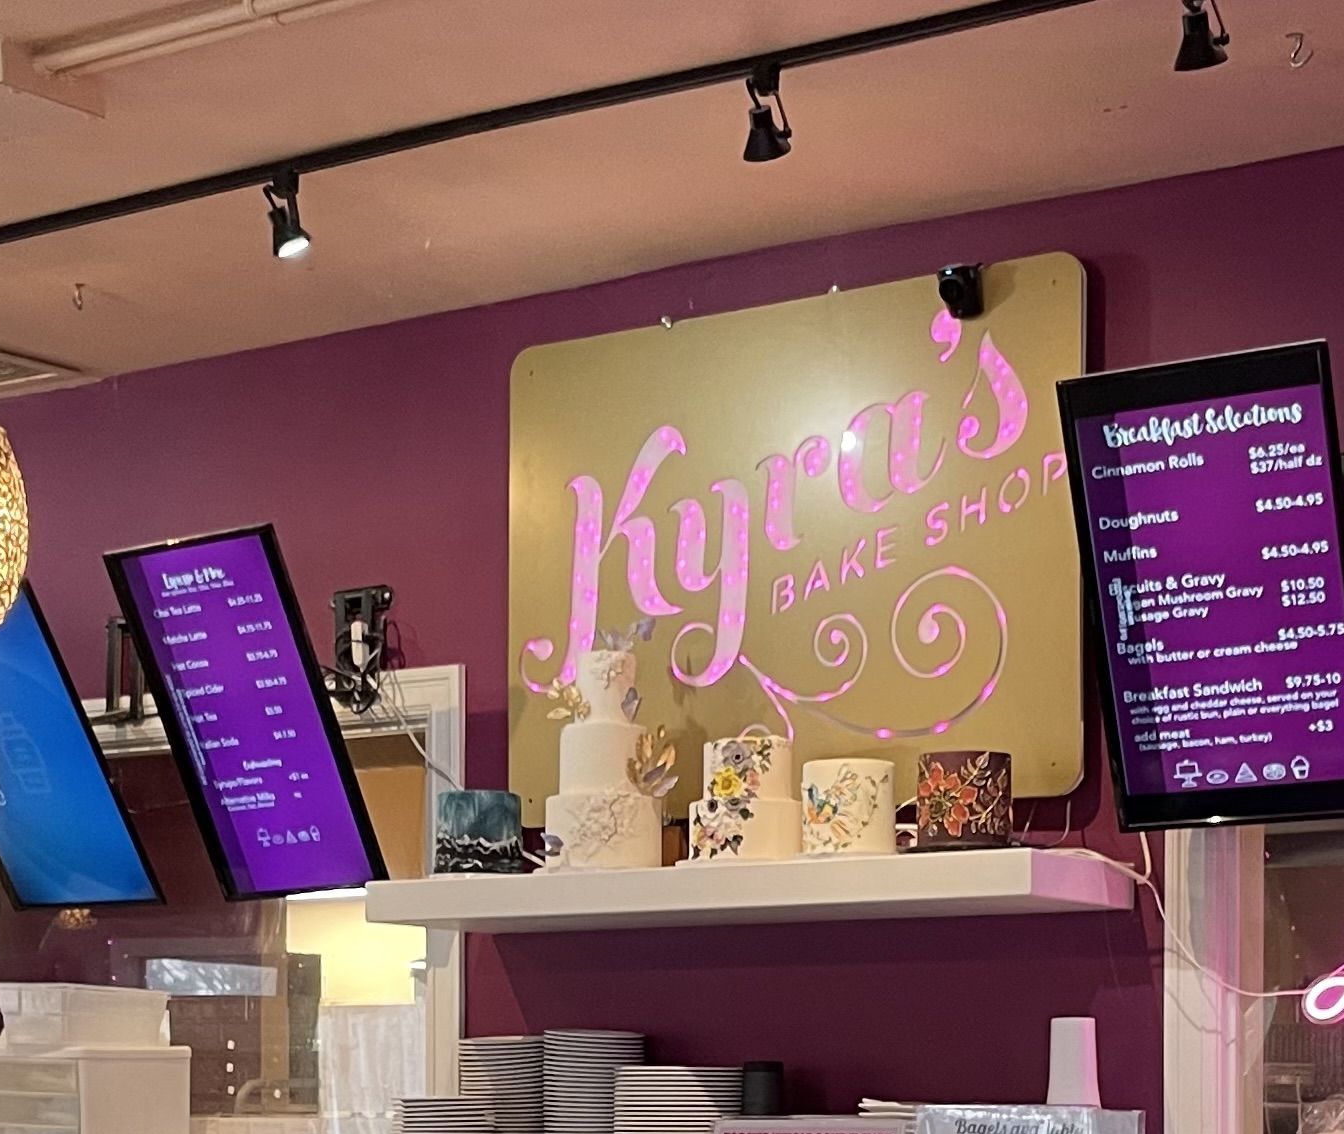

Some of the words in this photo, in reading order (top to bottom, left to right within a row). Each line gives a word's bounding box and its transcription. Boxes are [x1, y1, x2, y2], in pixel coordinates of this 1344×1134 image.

[1102, 412, 1204, 448] Breakfast
[1204, 402, 1303, 434] Selections
[1091, 460, 1165, 479] Cinnamon
[1168, 452, 1205, 470] Rolls
[1250, 455, 1303, 474] $37/half
[1305, 453, 1323, 467] dz
[520, 309, 1029, 693] Kyra's
[1255, 492, 1324, 512] $4.50-4.95
[1098, 510, 1179, 530] Doughnuts
[772, 526, 899, 615] BAKE
[925, 452, 1067, 546] SHOP
[1103, 545, 1158, 563] Muffins
[1261, 540, 1329, 560] $4.50-4.95
[1165, 575, 1178, 591] &
[1181, 573, 1226, 589] Gravy
[1280, 576, 1325, 593] $10.50
[1157, 590, 1224, 609] Mushroom
[1225, 586, 1264, 599] Gravy
[1281, 590, 1326, 607] $12.50
[1171, 606, 1209, 619] Gravy
[1116, 637, 1165, 657] Bagels
[1123, 685, 1190, 703] Breakfast
[1192, 677, 1263, 698] Sandwich
[1285, 672, 1342, 689] $9.75-10
[1134, 731, 1157, 742] add
[1159, 728, 1191, 742] meat
[1308, 719, 1334, 732] +$3
